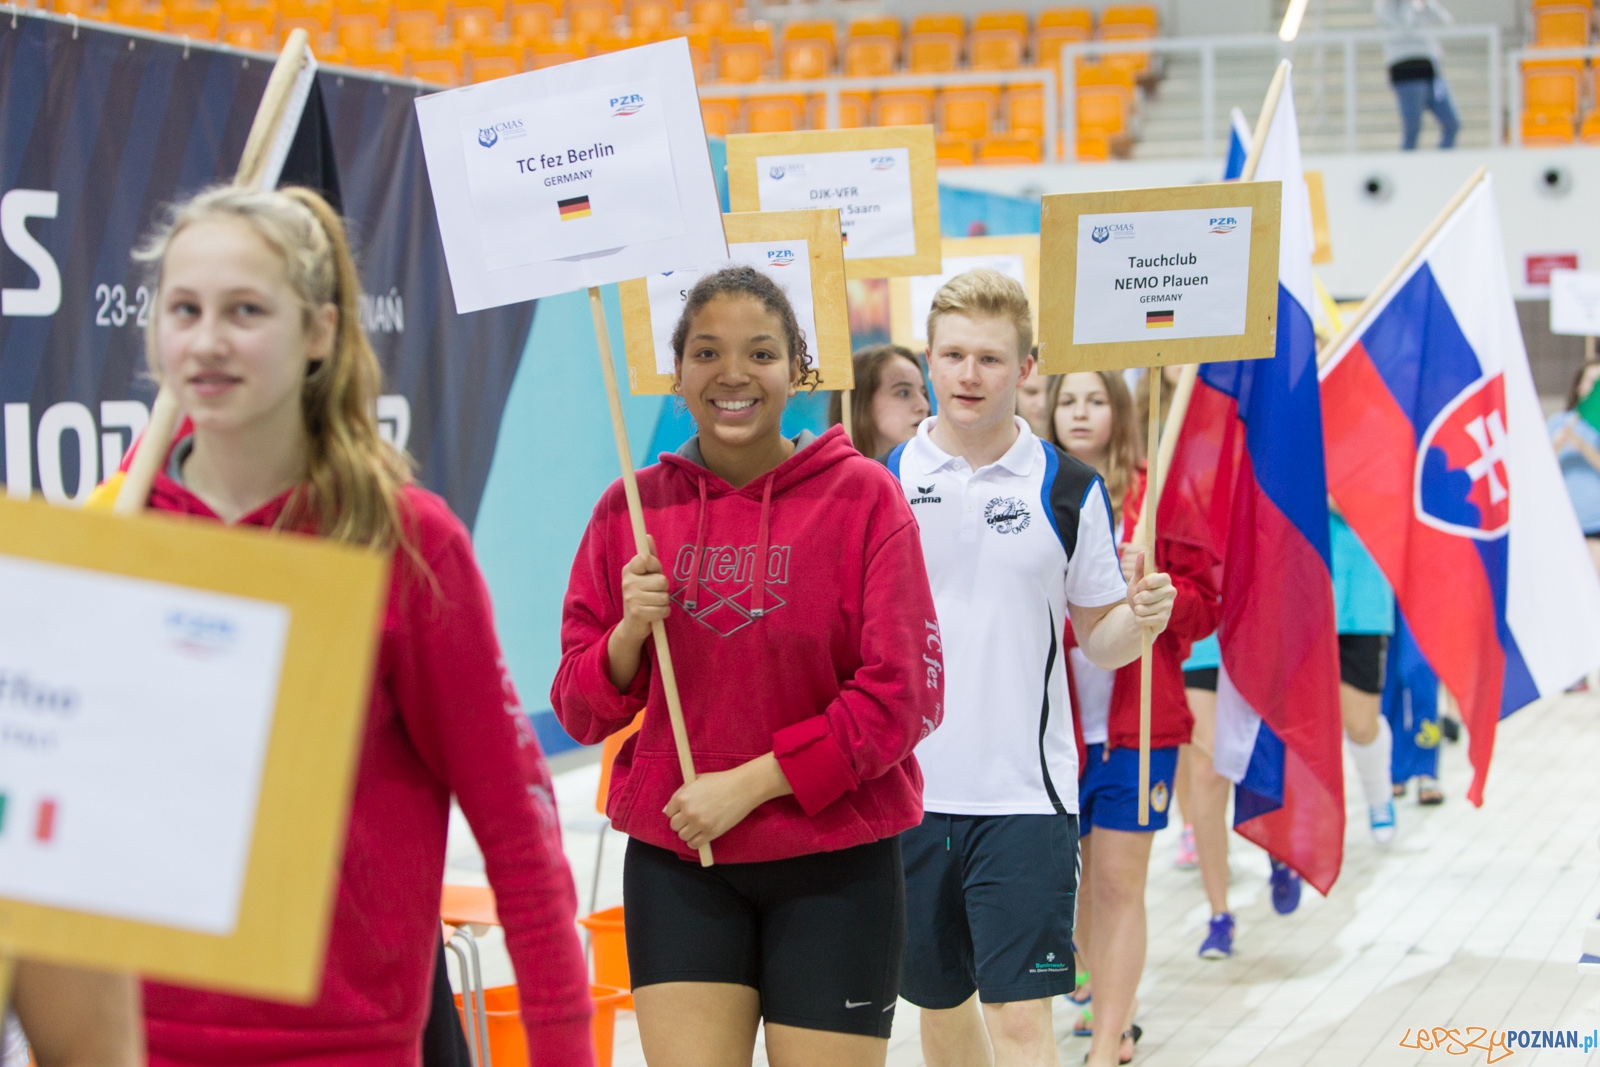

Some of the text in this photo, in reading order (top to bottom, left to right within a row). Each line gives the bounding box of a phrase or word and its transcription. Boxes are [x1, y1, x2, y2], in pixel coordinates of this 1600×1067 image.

[495, 118, 523, 132] CMAS
[516, 142, 615, 174] TC fez Berlin
[544, 168, 593, 187] GERMANY
[809, 186, 858, 200] DJK-VFR
[847, 203, 881, 215] Saarn
[1109, 223, 1134, 232] CMAS
[1128, 252, 1197, 268] Tauchclub
[1114, 274, 1209, 291] NEMO Plauen
[95, 284, 151, 328] 23-2
[1139, 293, 1183, 303] GERMANY
[910, 495, 942, 505] erima
[673, 543, 791, 585] arena
[922, 618, 942, 690] TC fez
